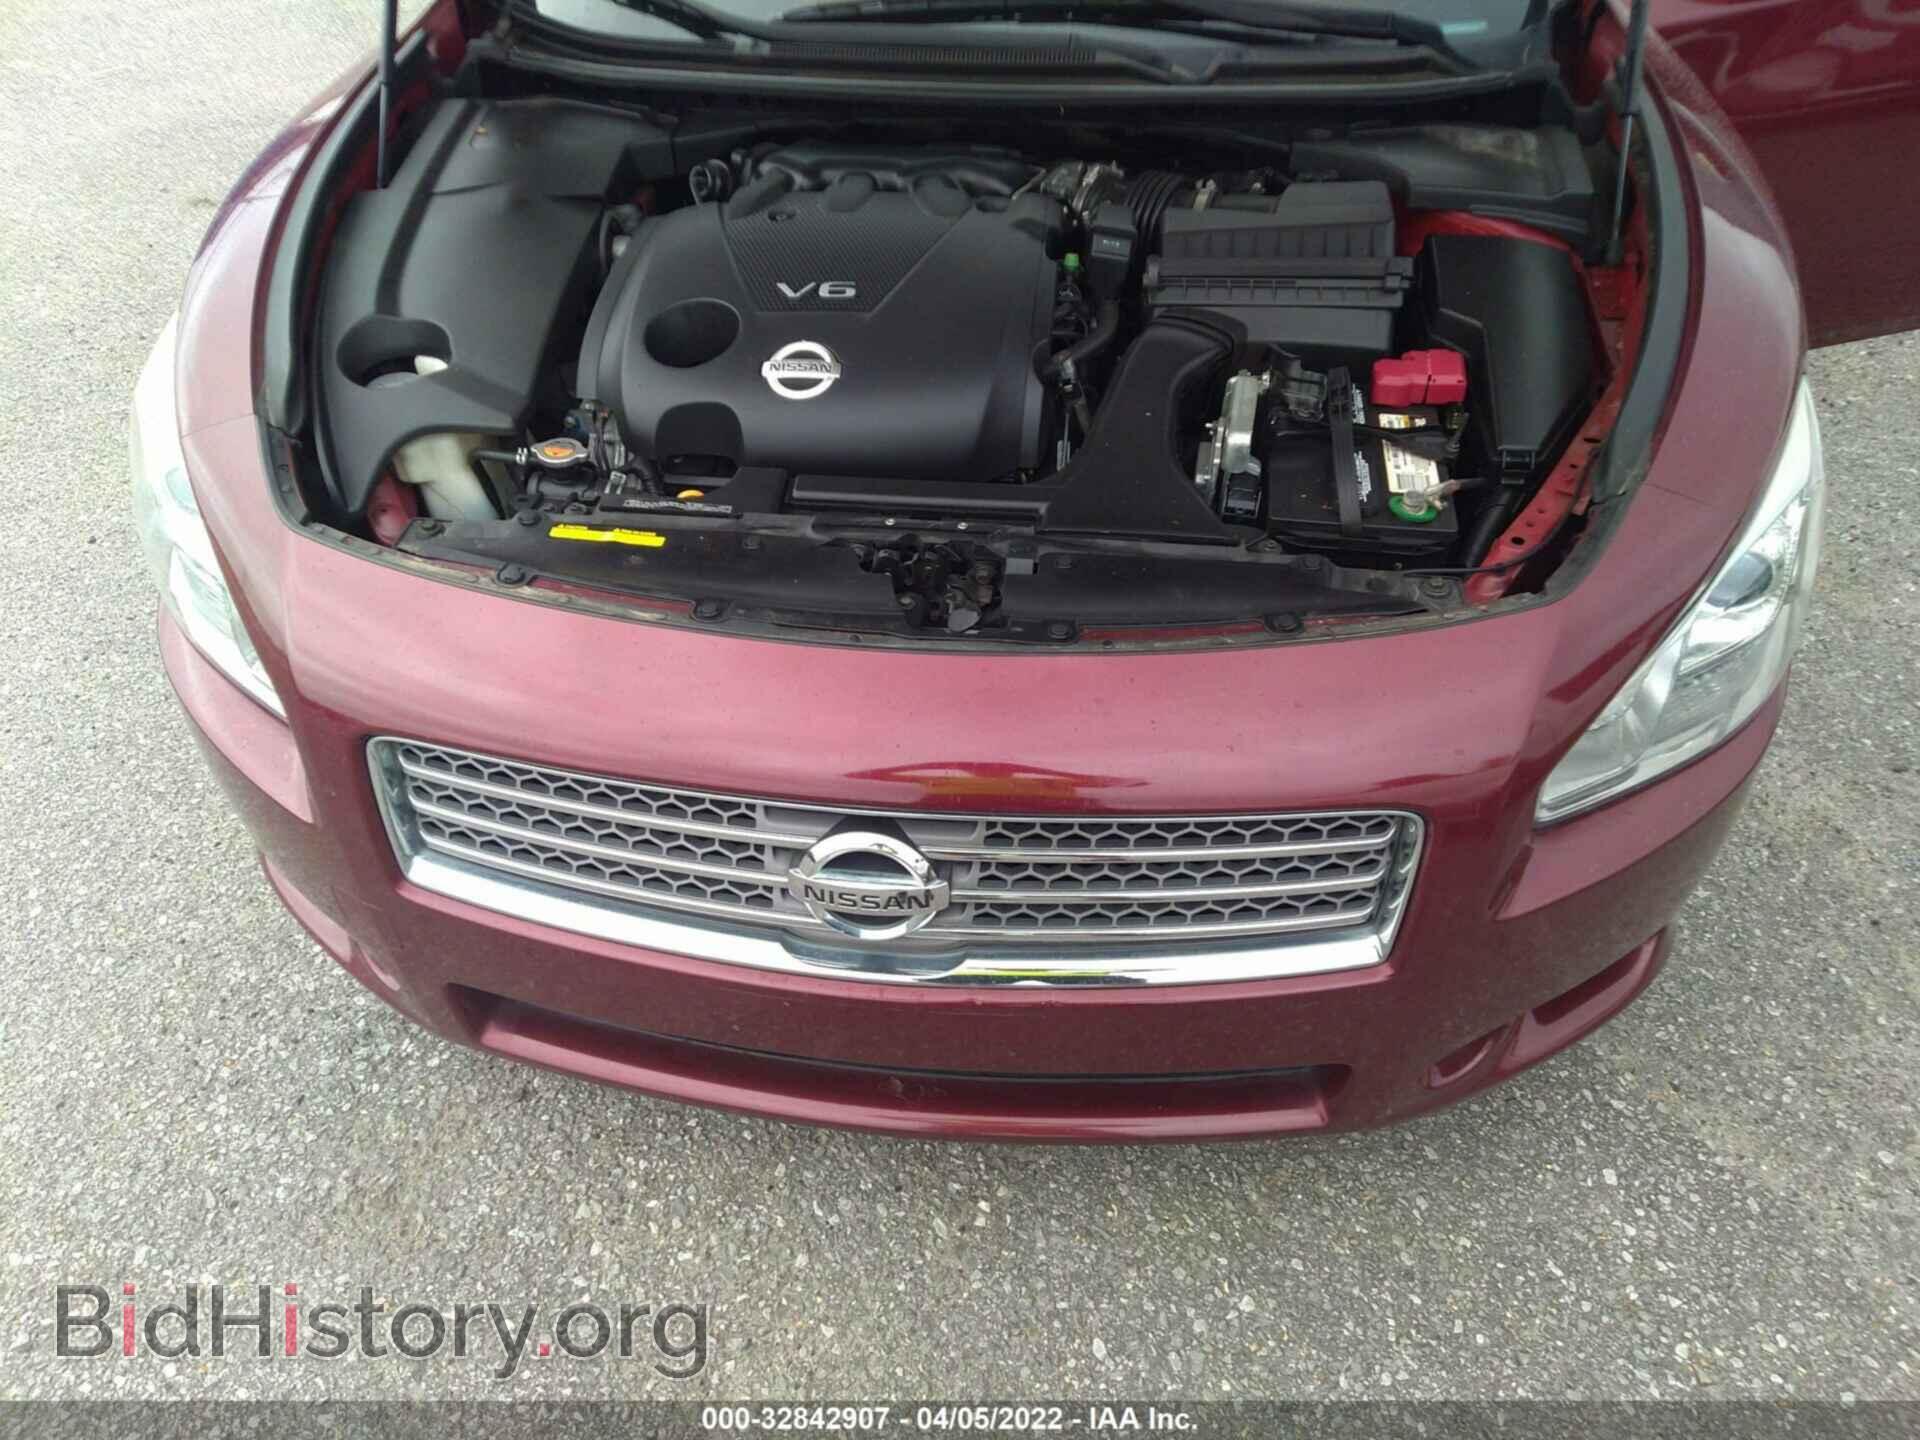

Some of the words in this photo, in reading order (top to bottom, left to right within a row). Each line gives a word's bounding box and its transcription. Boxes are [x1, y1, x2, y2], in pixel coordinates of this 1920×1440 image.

[776, 280, 856, 298] V6
[768, 361, 833, 374] NISSAN
[803, 884, 935, 911] NISSAN
